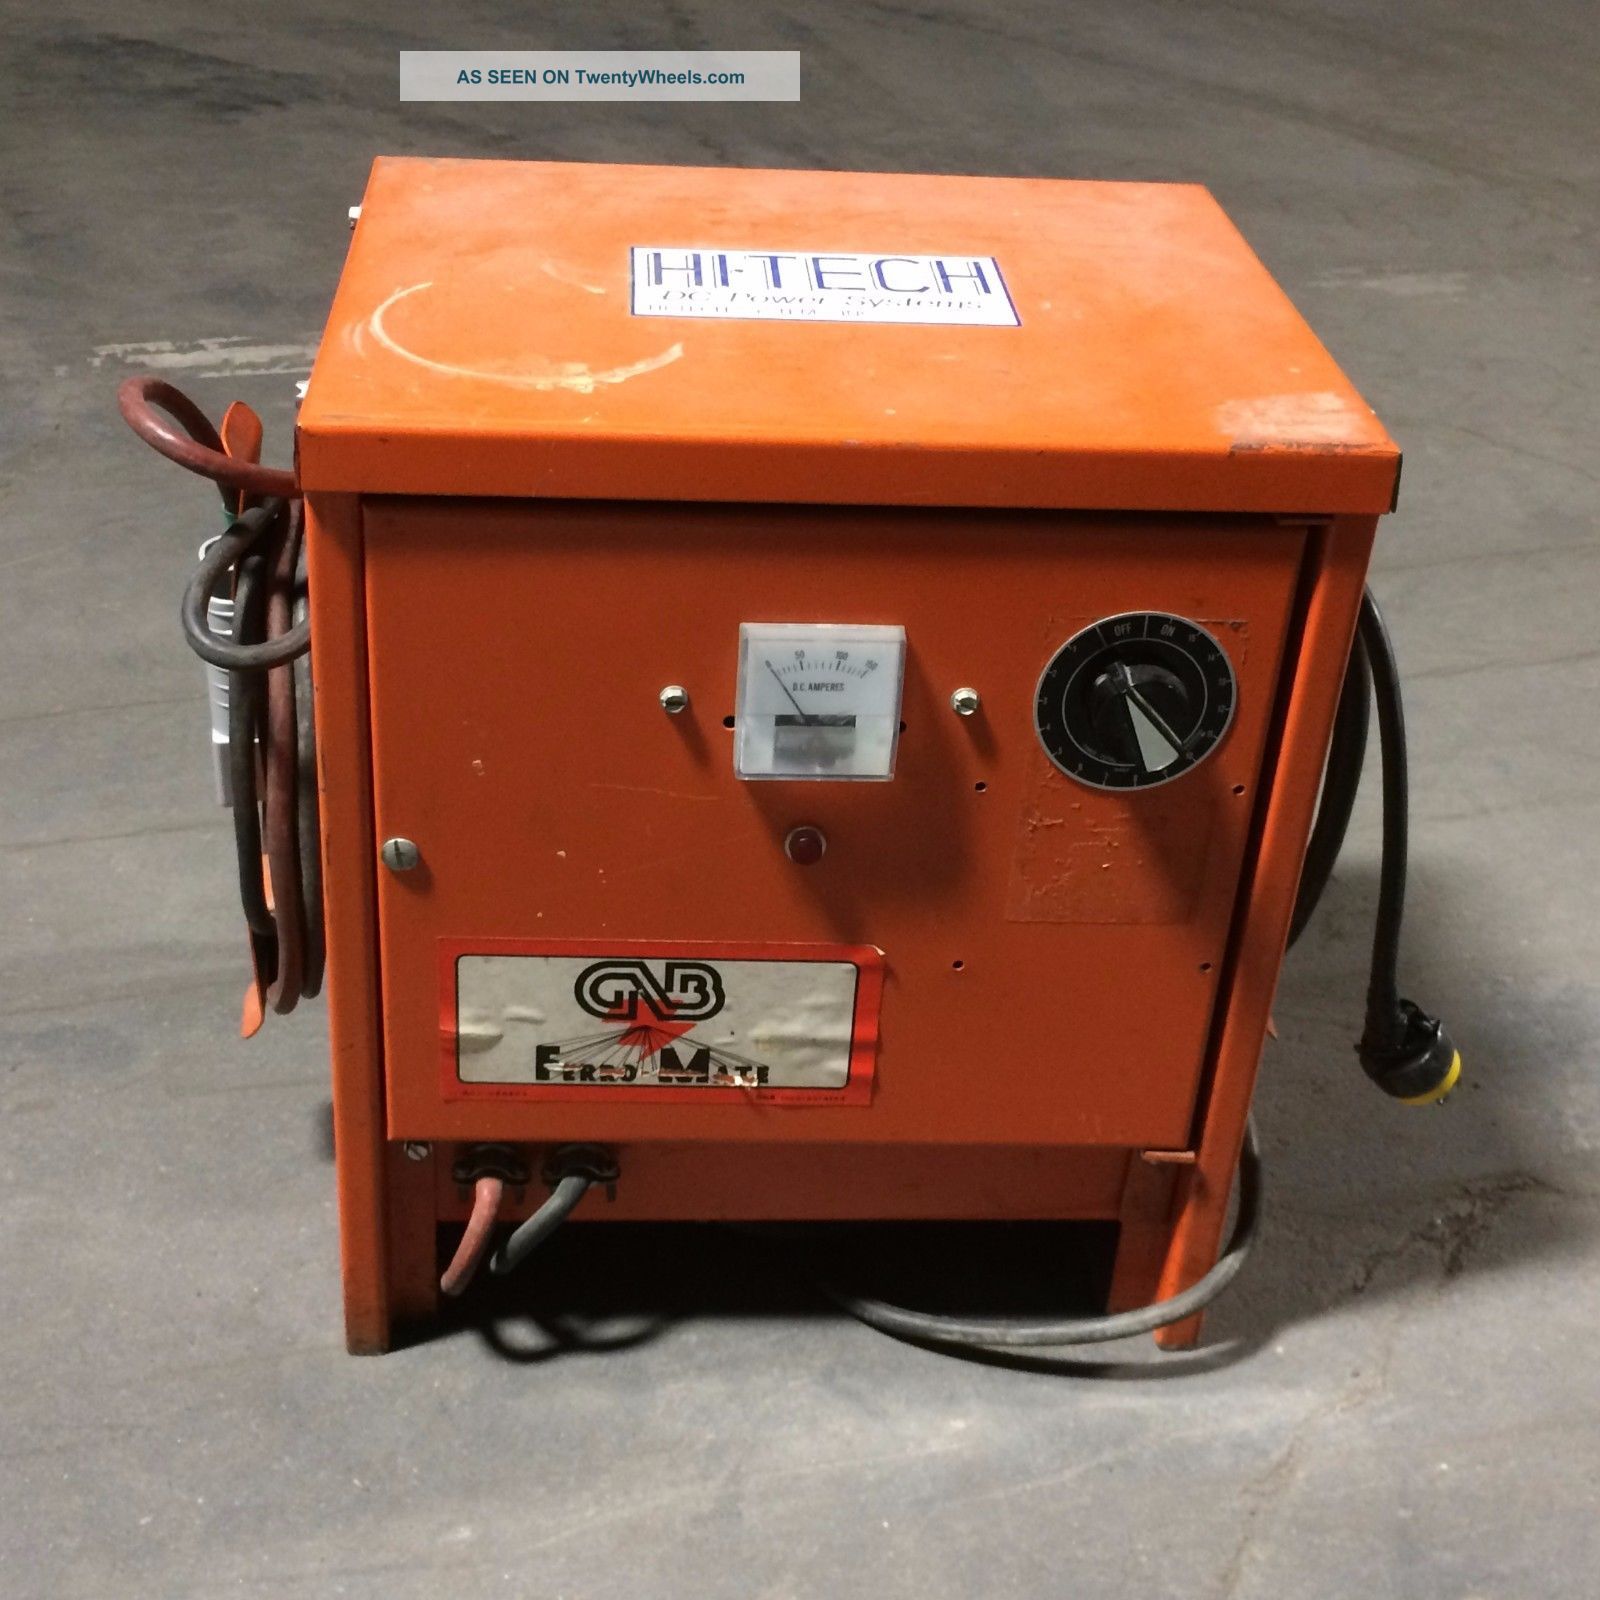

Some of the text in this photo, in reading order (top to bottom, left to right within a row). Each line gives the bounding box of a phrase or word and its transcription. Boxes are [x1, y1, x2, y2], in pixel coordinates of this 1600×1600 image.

[647, 252, 992, 295] HI-TECH
[1113, 623, 1175, 637] OFF ON
[794, 650, 805, 660] 50
[808, 682, 845, 692] AMPERES
[573, 960, 726, 1022] GNB
